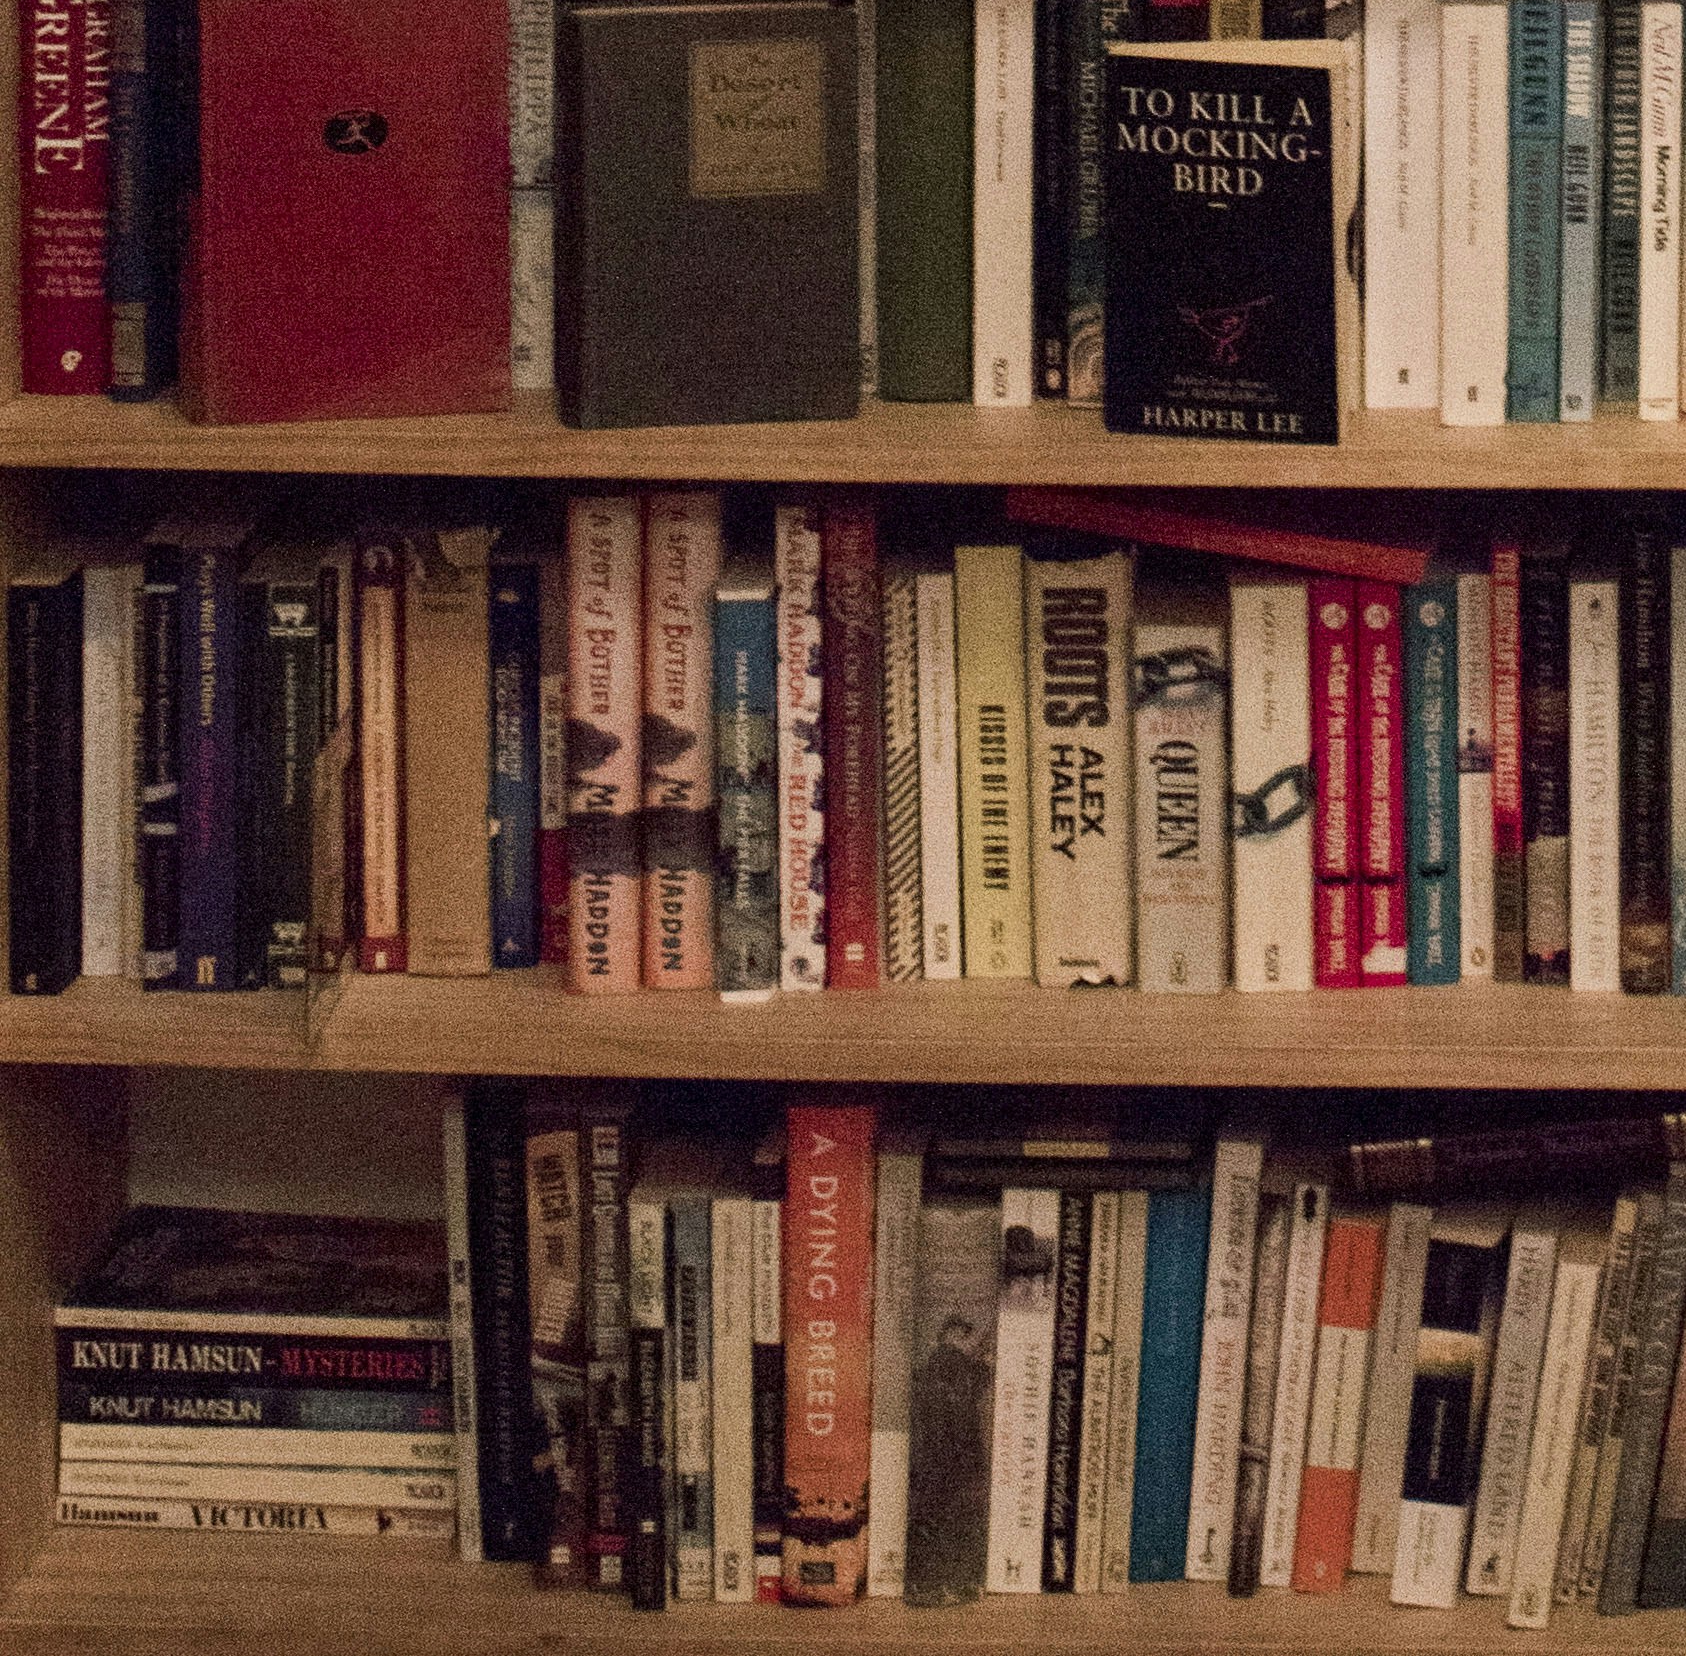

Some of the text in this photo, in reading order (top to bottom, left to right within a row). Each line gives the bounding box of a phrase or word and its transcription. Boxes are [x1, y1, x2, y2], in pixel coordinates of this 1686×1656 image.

[1121, 88, 1313, 127] TO KILL A
[1116, 124, 1323, 163] MOCKING-
[1172, 163, 1265, 197] BIRD
[1142, 407, 1305, 435] HARPER LEE
[1049, 744, 1075, 861] HALEY
[1077, 745, 1105, 837] ALEX
[1150, 739, 1200, 862] QUEEN
[587, 870, 612, 977] HADDON
[660, 865, 686, 972] HADDON
[804, 1132, 839, 1438] A DYING BREED
[73, 1340, 427, 1381] KNUT HAMSUN MYSTERIES
[89, 1394, 263, 1423] KNUT HAMSUN
